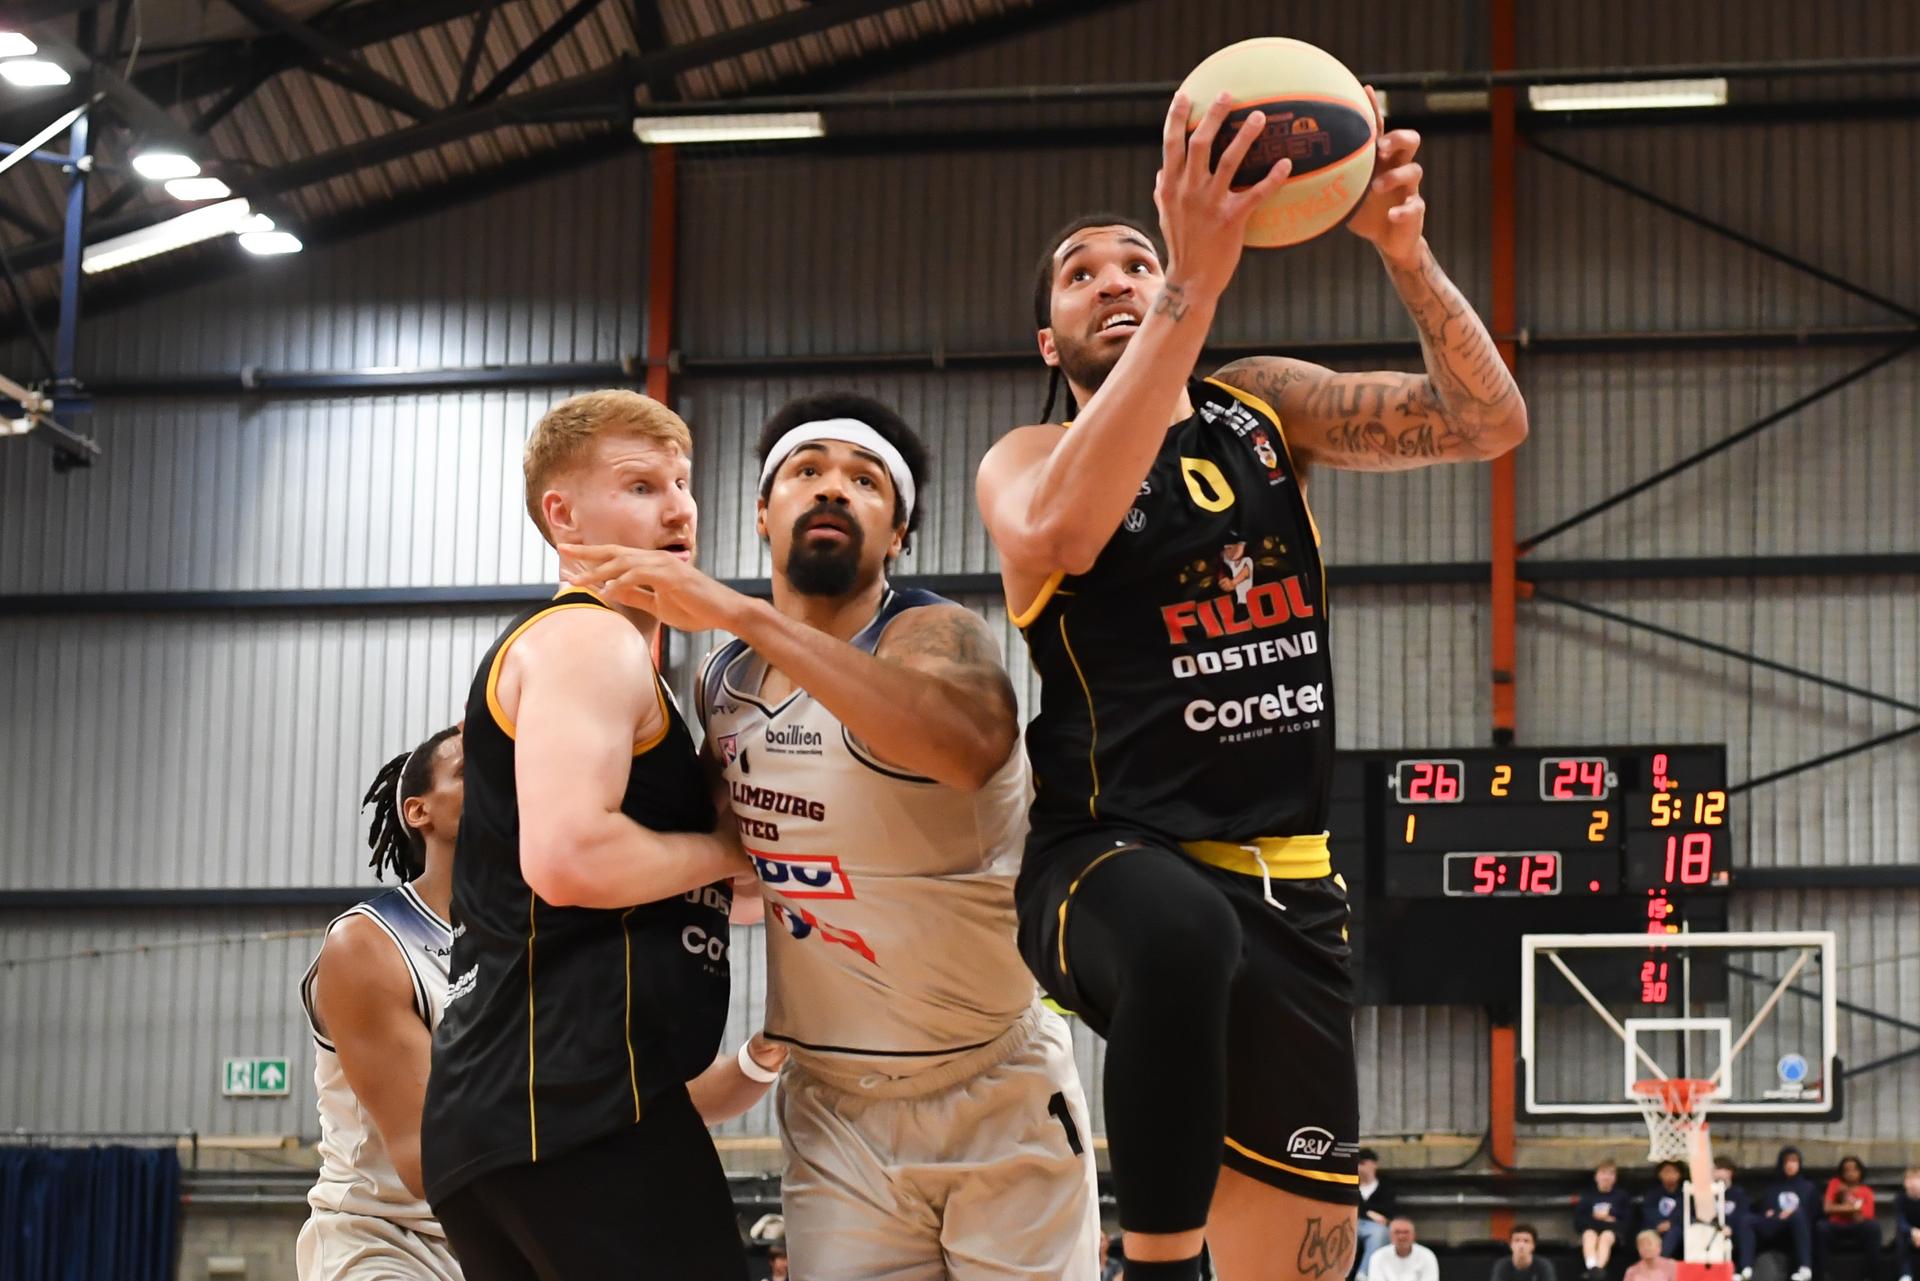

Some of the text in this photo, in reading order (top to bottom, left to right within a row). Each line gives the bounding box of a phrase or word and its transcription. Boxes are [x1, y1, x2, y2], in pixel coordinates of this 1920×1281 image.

[1180, 456, 1235, 513] 0
[1160, 575, 1314, 645] FILOL
[1172, 630, 1318, 679] OOSTEND
[765, 724, 822, 745] baillien
[1219, 727, 1273, 743] PREMIUM
[1409, 763, 1457, 801] 26
[1491, 765, 1512, 796] 2
[1553, 760, 1603, 799] 24
[732, 781, 825, 822] LIMBURG
[1651, 791, 1725, 826] 5:12
[1406, 814, 1415, 843] 1
[1588, 811, 1609, 841] 2
[1474, 854, 1556, 894] 5:12
[1665, 832, 1711, 884] 18
[1642, 982, 1668, 1003] 30
[1048, 1091, 1084, 1155] 1
[1293, 1137, 1332, 1155] P&V
